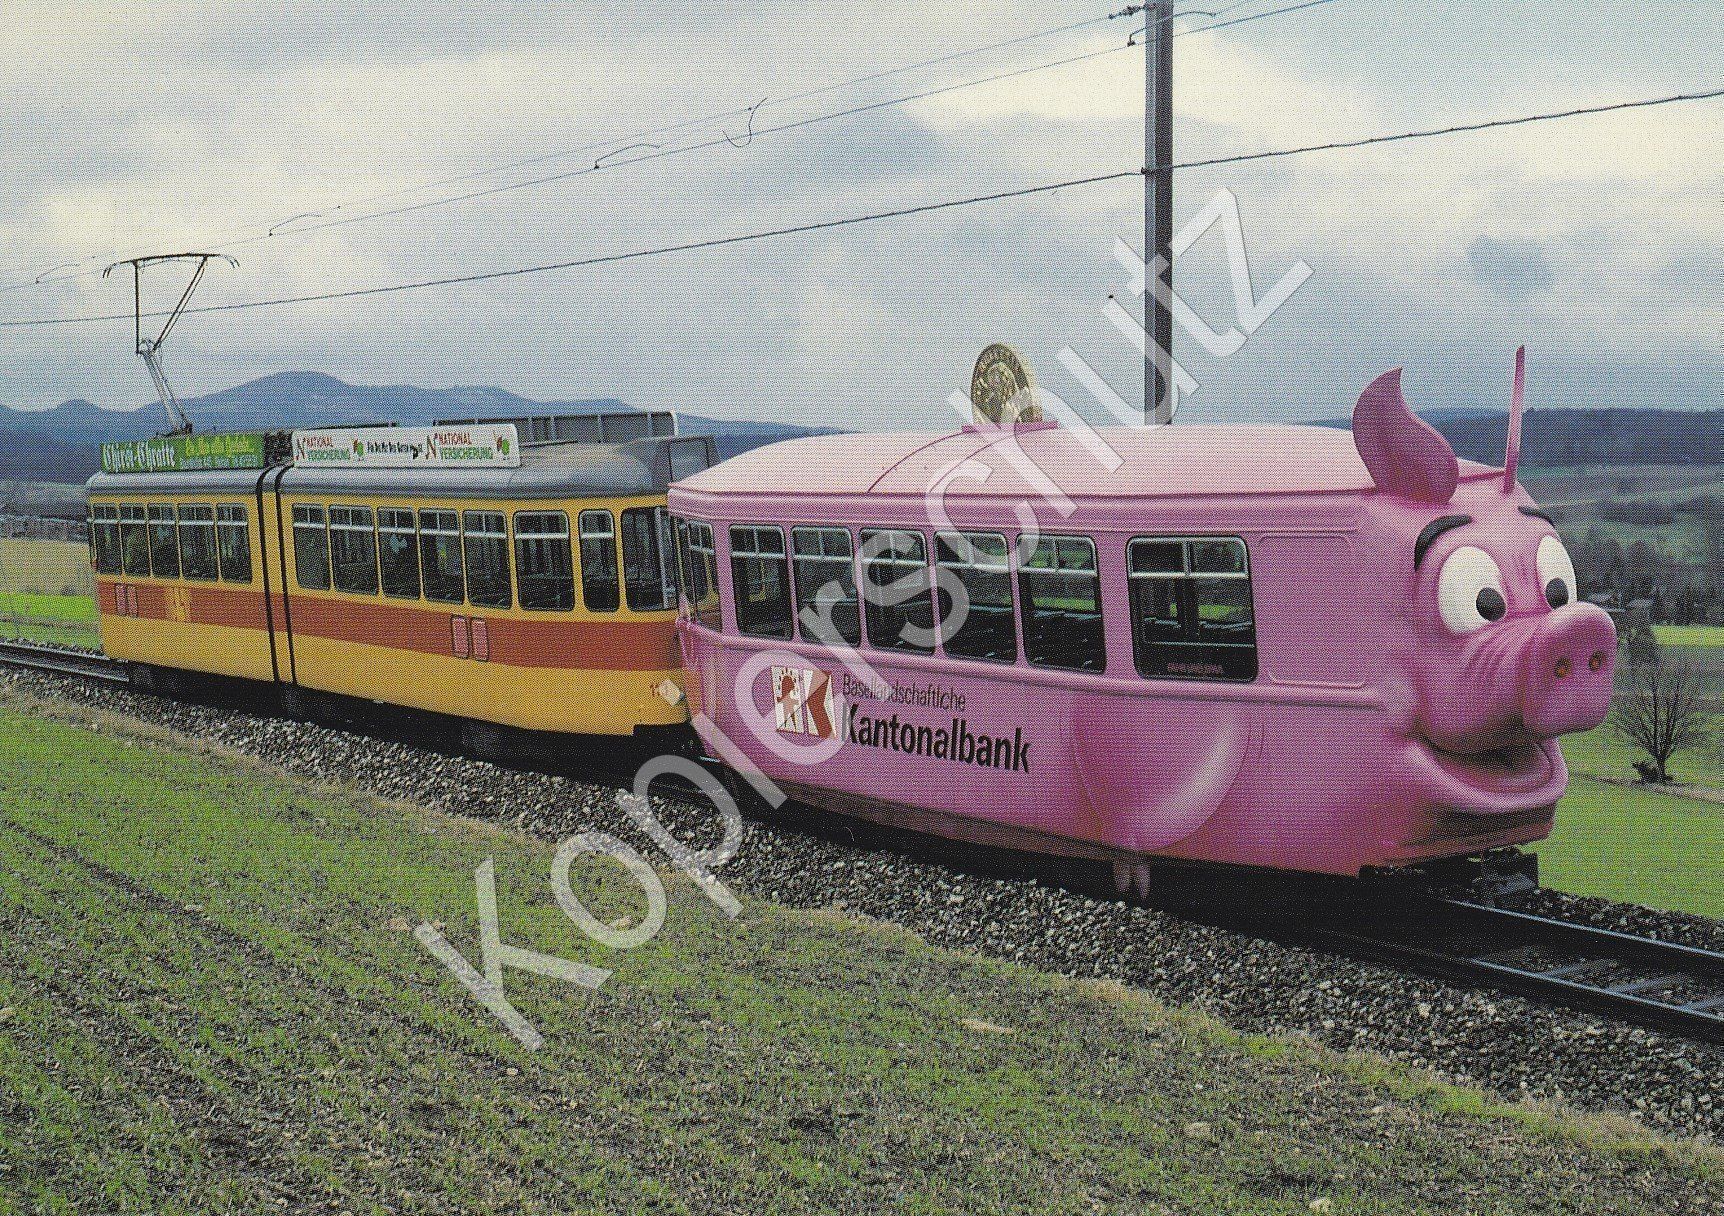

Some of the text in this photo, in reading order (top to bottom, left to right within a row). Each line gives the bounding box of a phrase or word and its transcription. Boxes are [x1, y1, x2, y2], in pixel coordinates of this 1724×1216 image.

[306, 436, 334, 448] NATIONAL
[438, 432, 472, 446] NATIONAL
[307, 448, 351, 461] VERSICHERUNG
[440, 446, 494, 460] VERSICHERUNG
[842, 673, 966, 713] Basellandschaftliche
[841, 703, 1030, 774] Kantonalbank
